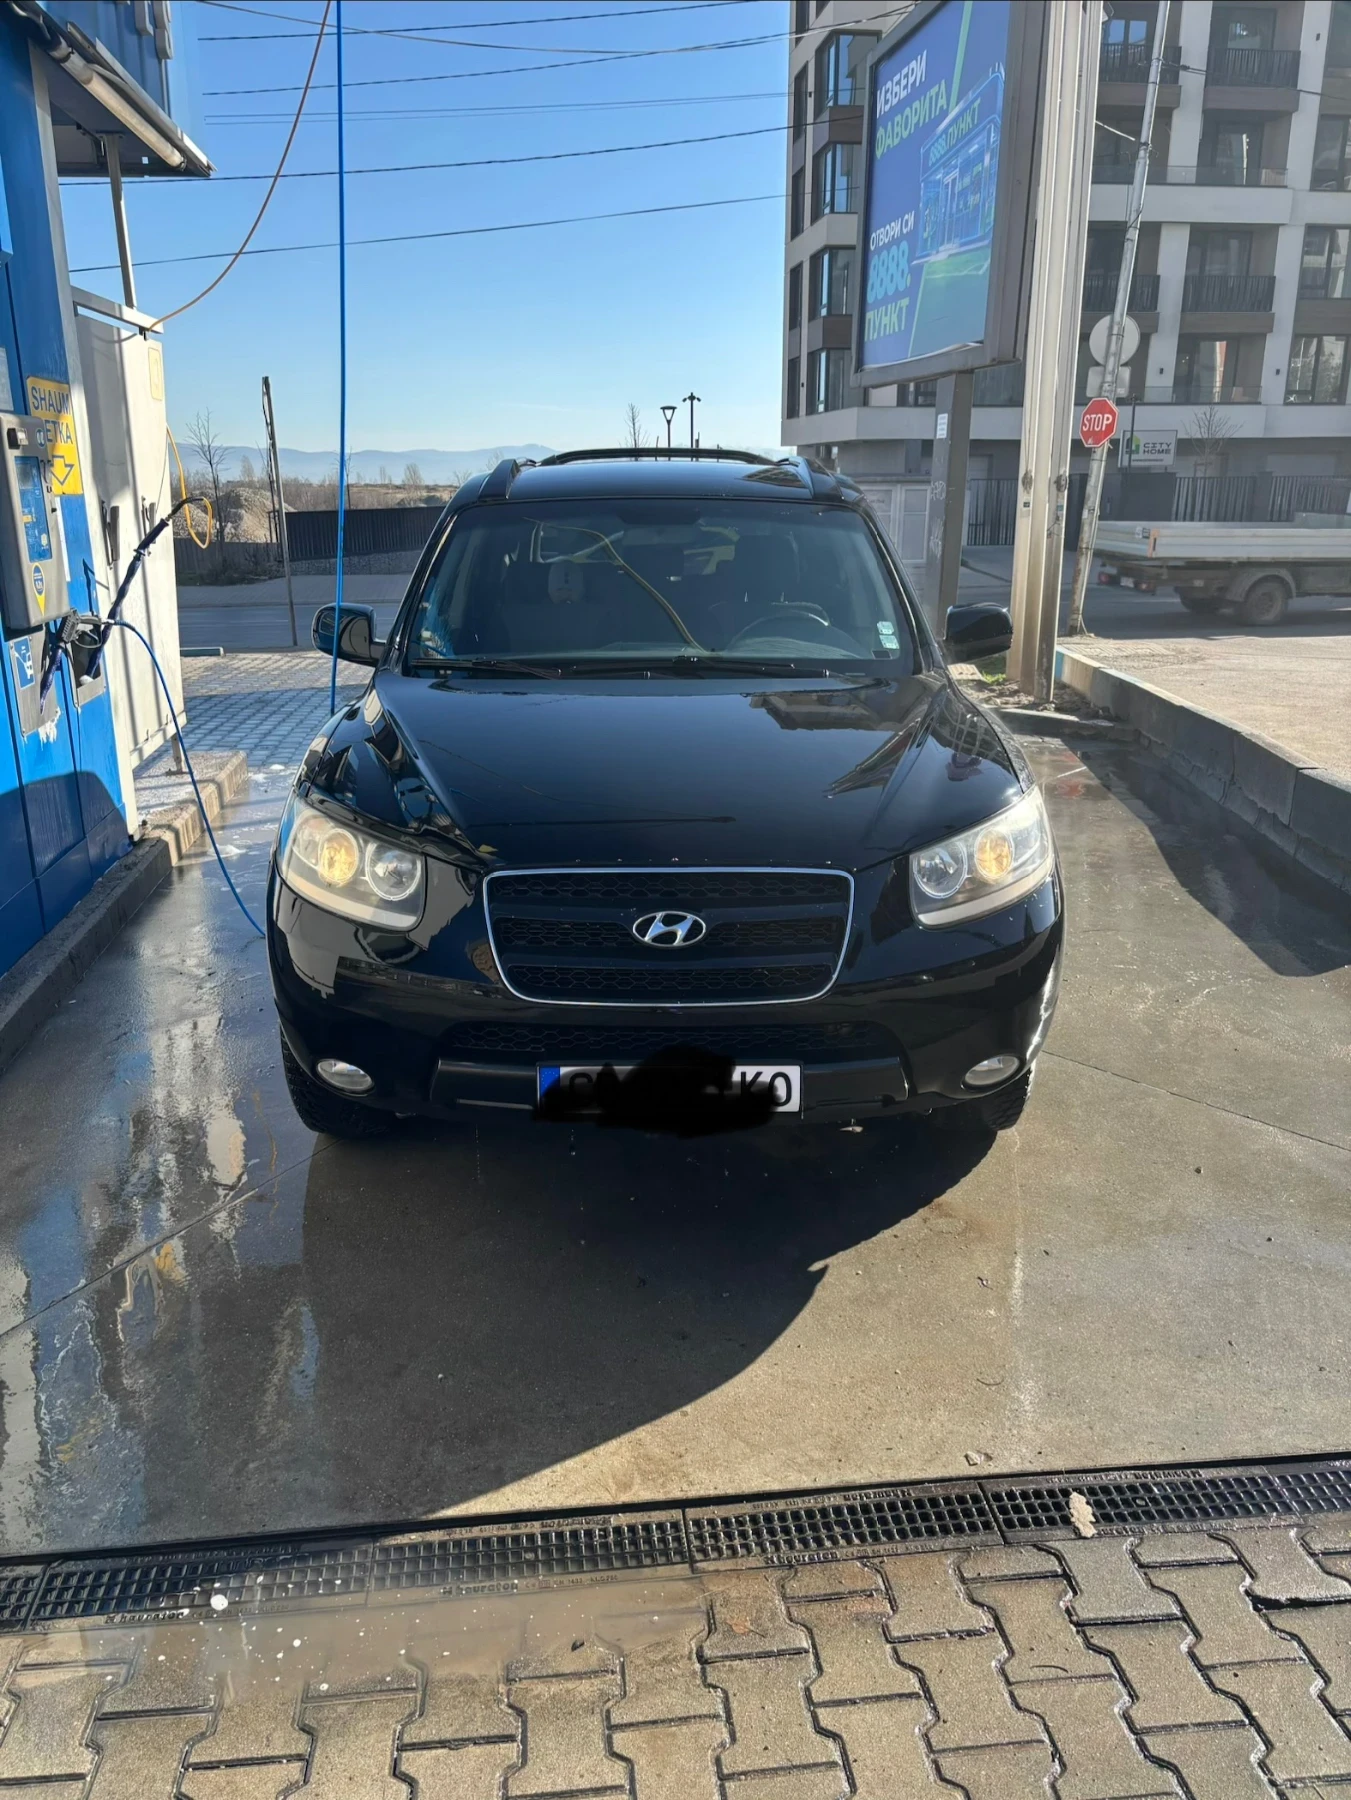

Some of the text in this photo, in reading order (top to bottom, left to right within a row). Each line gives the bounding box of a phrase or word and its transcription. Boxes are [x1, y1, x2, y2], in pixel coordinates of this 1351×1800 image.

[876, 49, 927, 119] ИЗБЕРИ
[875, 79, 947, 160] ФАВОРИТА
[870, 211, 914, 251] ОТВОРИ СИ
[864, 297, 910, 342] ПУНКТ
[1082, 413, 1113, 432] STOP
